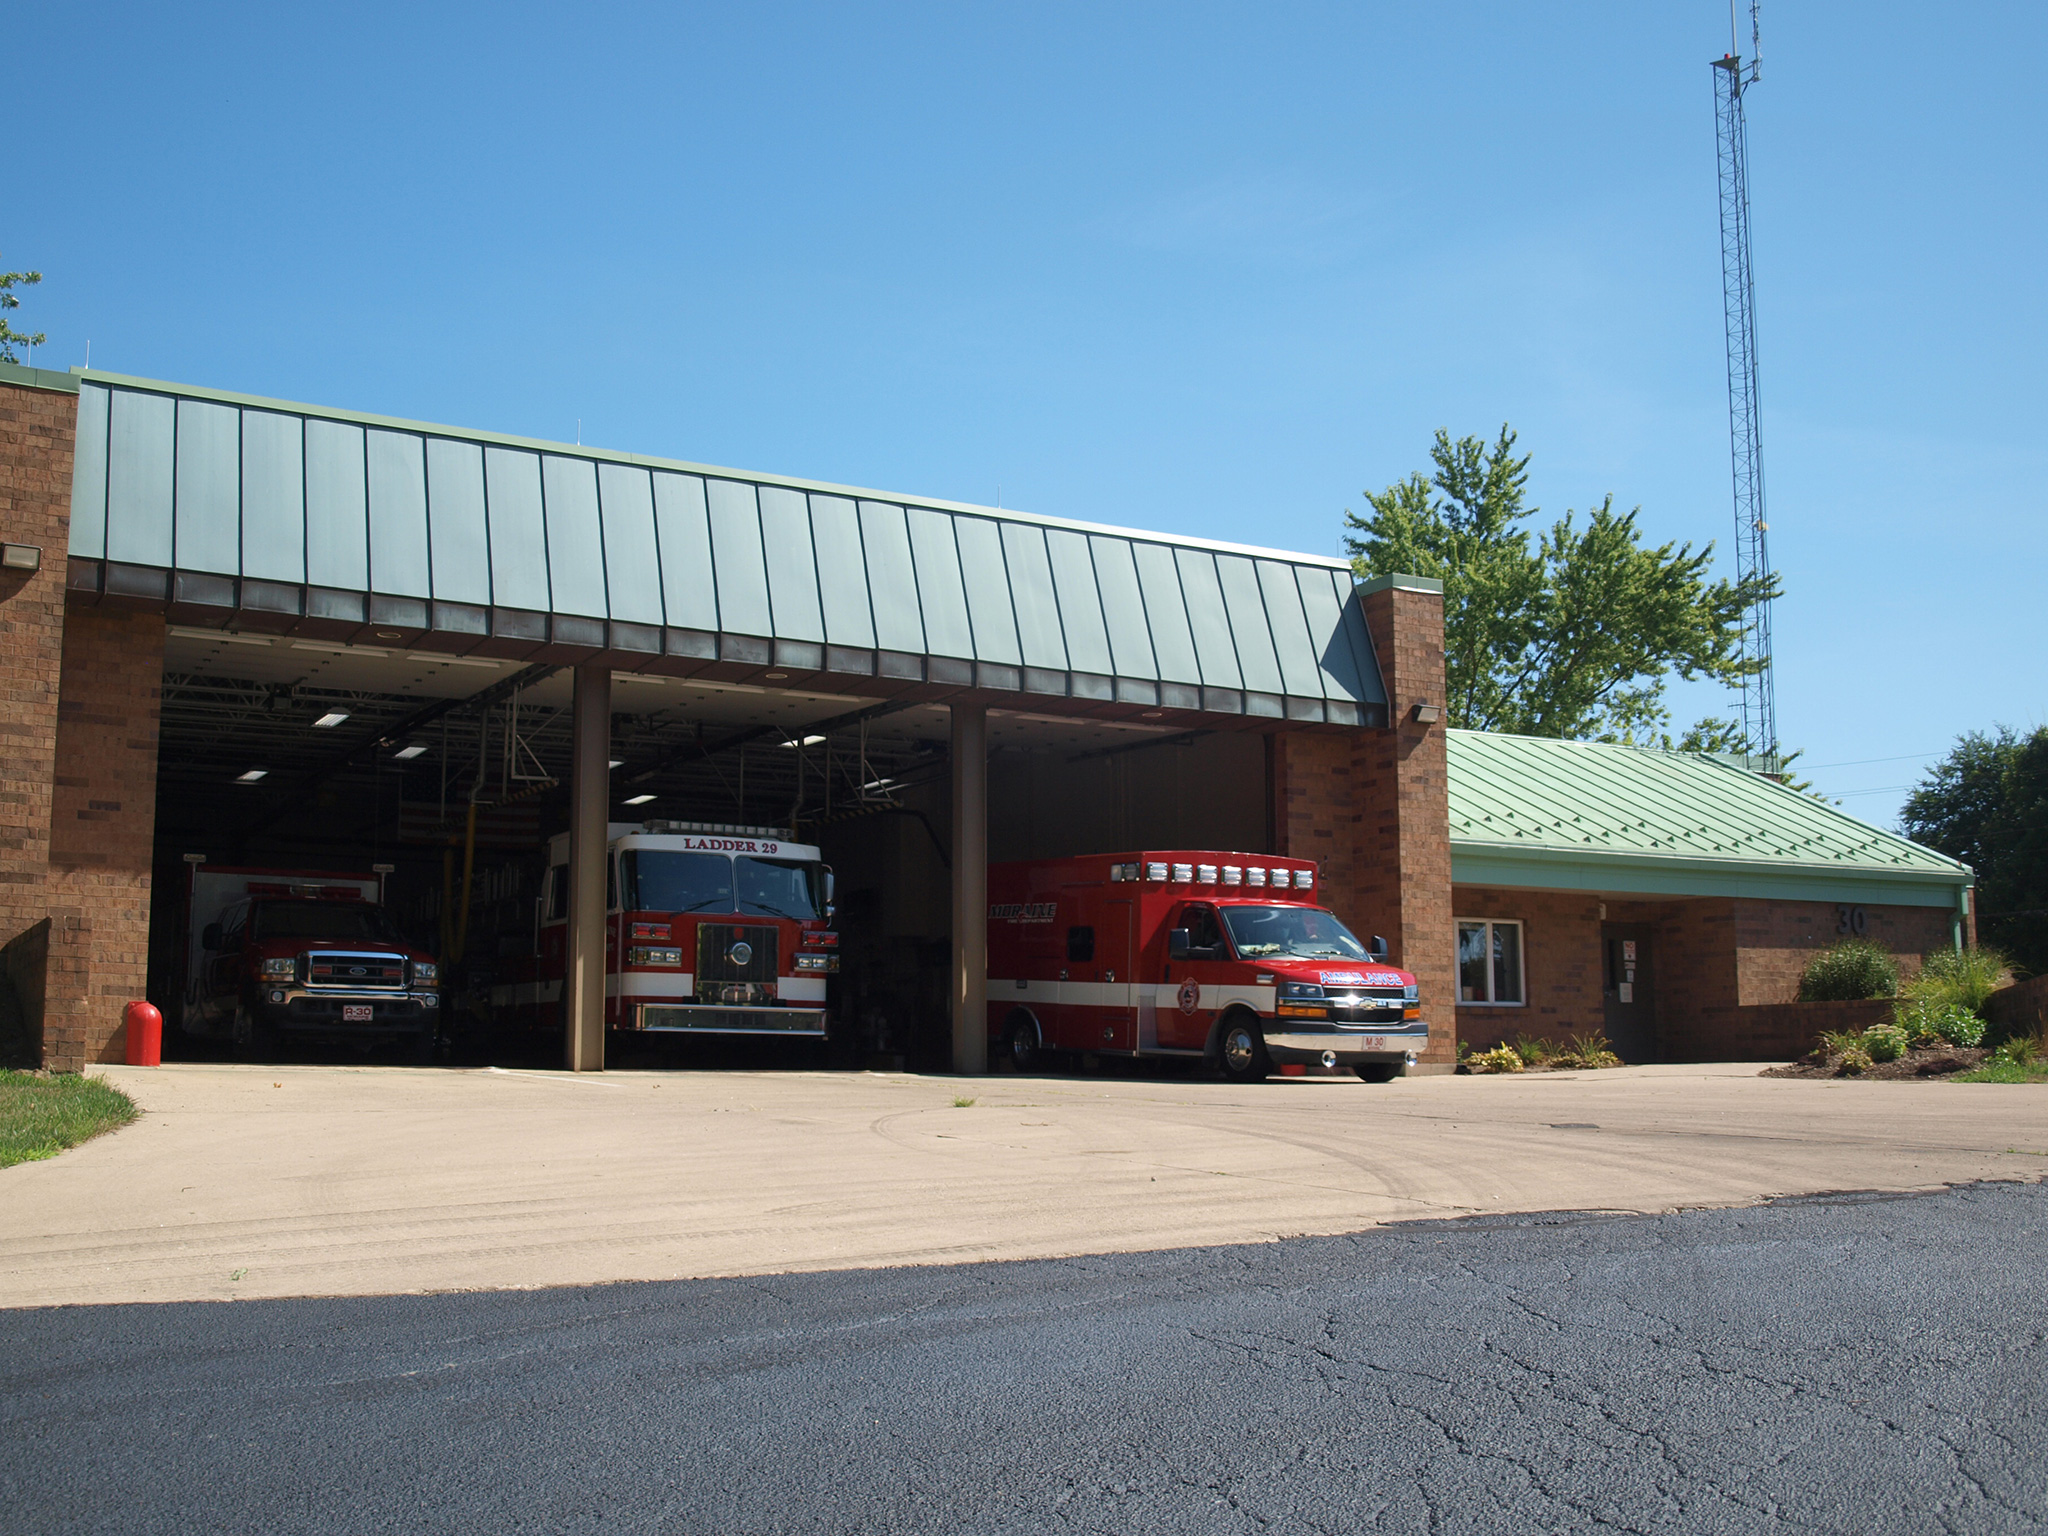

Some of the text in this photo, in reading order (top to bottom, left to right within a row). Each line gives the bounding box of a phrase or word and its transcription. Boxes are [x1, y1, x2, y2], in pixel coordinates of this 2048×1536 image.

[684, 838, 778, 854] LADDER 29
[988, 903, 1057, 918] MORAINE
[1837, 904, 1868, 934] 30
[1319, 971, 1404, 985] AMBULANCE
[345, 1007, 371, 1015] R-30
[1366, 1037, 1383, 1046] M 30
